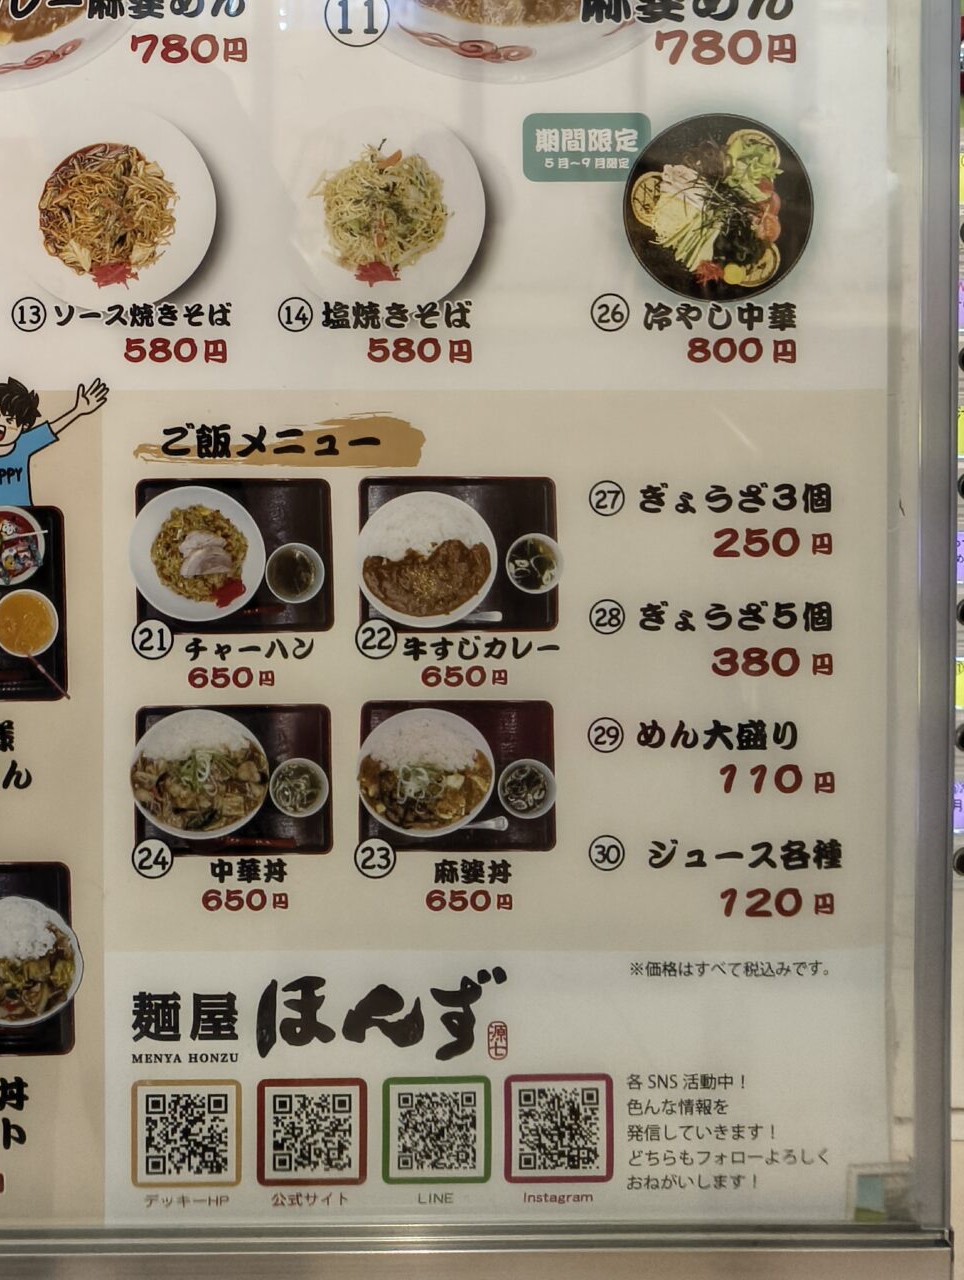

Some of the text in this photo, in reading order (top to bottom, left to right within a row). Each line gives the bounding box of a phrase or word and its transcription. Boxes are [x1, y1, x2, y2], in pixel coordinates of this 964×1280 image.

[129, 32, 249, 65] 780円
[654, 30, 798, 65] 780円
[535, 127, 638, 152] 期間限定
[54, 302, 233, 328] ソース焼きそば
[321, 300, 472, 331] 塩焼きそば
[643, 301, 798, 331] 冷やし中華
[123, 338, 228, 364] 580円
[367, 337, 473, 364] 580円
[686, 337, 798, 364] 800円
[161, 422, 381, 459] ご飯メニュー
[639, 482, 833, 513] ぎょうざ3個
[712, 527, 833, 557] 250円
[639, 600, 833, 632] ぎょうざ5個
[184, 636, 315, 661] チャーハン
[402, 635, 561, 662] 牛すじカレー
[711, 647, 834, 677] 380円
[187, 665, 276, 689] 650円
[420, 664, 509, 688] 650円
[636, 719, 798, 750] めん大盛り
[719, 763, 836, 794] 110円
[648, 838, 842, 870] ジュース各種
[210, 858, 288, 884] 中華丼
[434, 858, 513, 884] 麻婆丼
[201, 888, 290, 912] 650円
[424, 888, 514, 912] 650円
[720, 887, 835, 917] 120円
[131, 991, 239, 1043] 麺屋
[131, 1052, 239, 1064] MENYA HONZU
[627, 1098, 729, 1116] 色んな情報を
[627, 1148, 829, 1167] どちらもフォローよろしく
[271, 1191, 349, 1207] 公式サイト
[417, 1192, 454, 1204] LINE
[523, 1191, 594, 1205] Instagram
